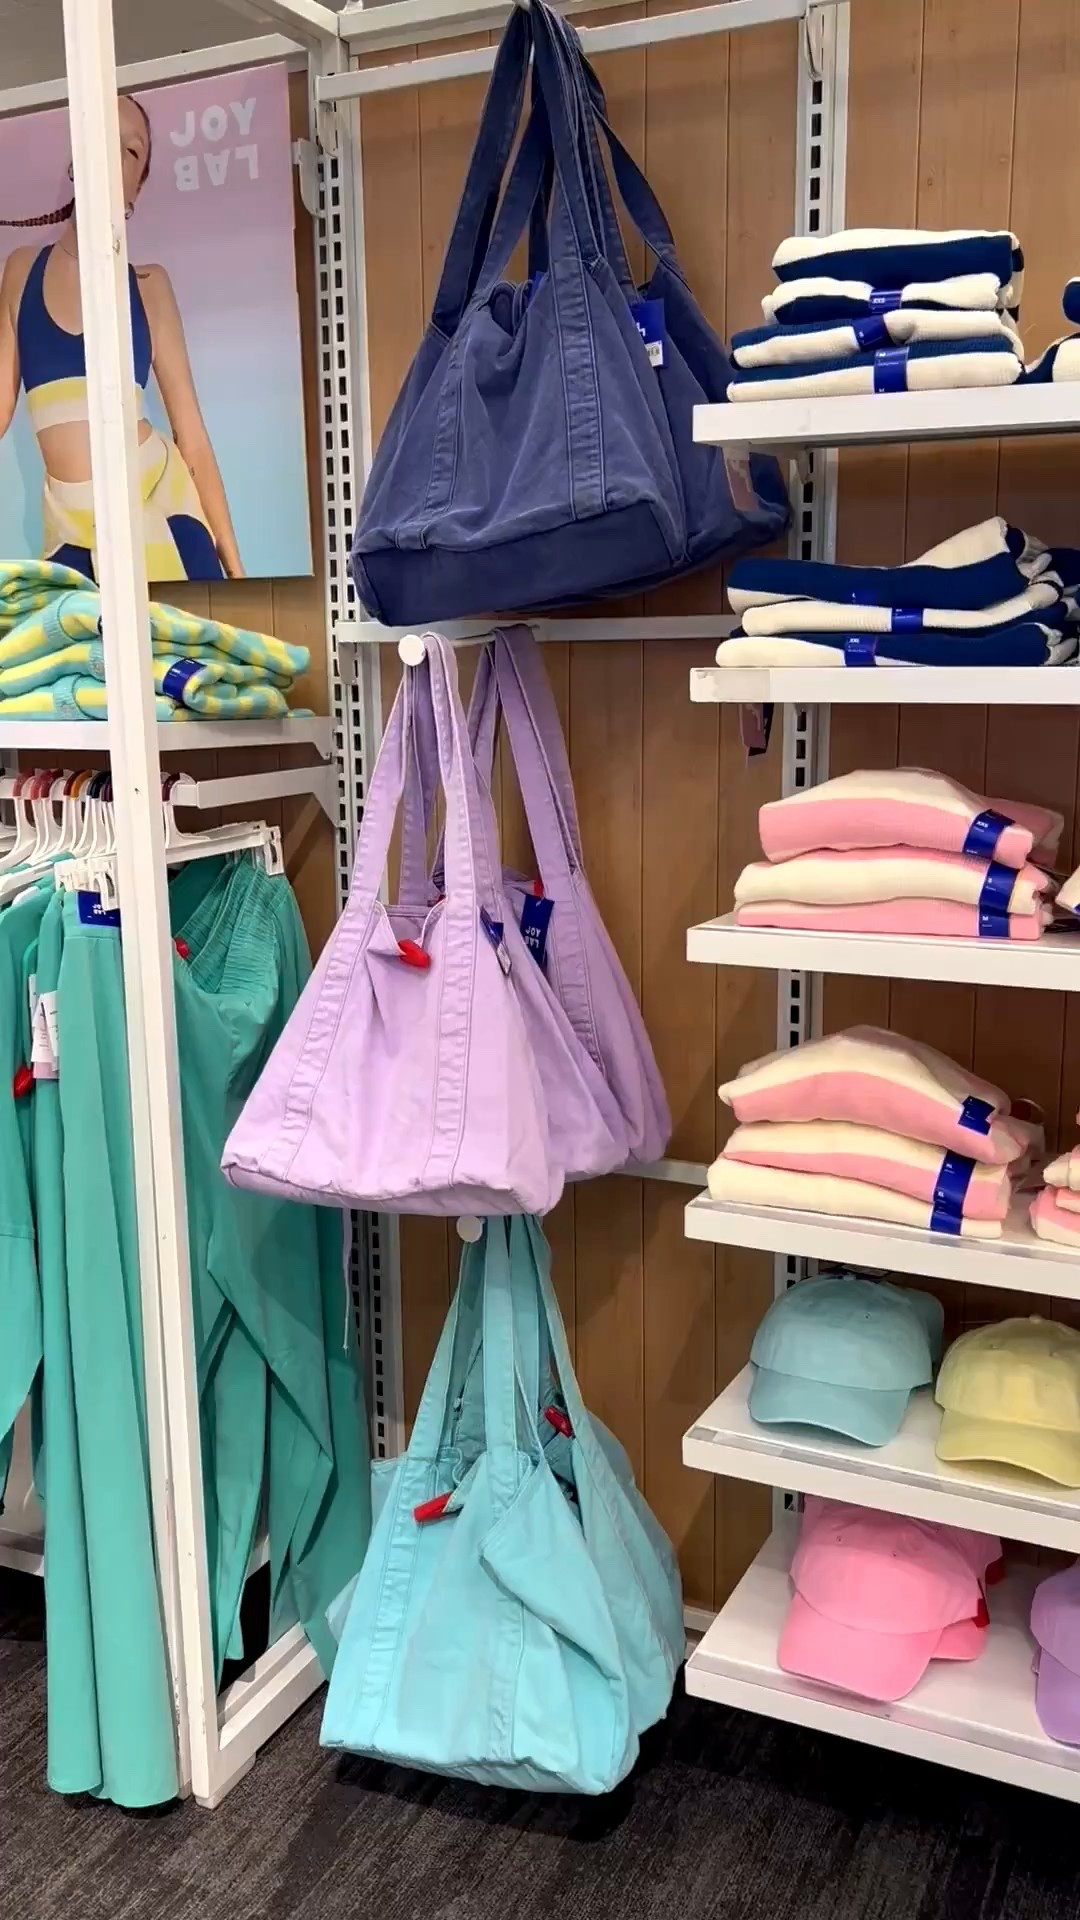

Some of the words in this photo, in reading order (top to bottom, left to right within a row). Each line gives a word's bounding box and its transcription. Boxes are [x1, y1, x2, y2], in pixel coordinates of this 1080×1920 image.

[169, 97, 257, 148] JOY
[173, 143, 259, 192] LAB
[525, 925, 541, 938] JOY
